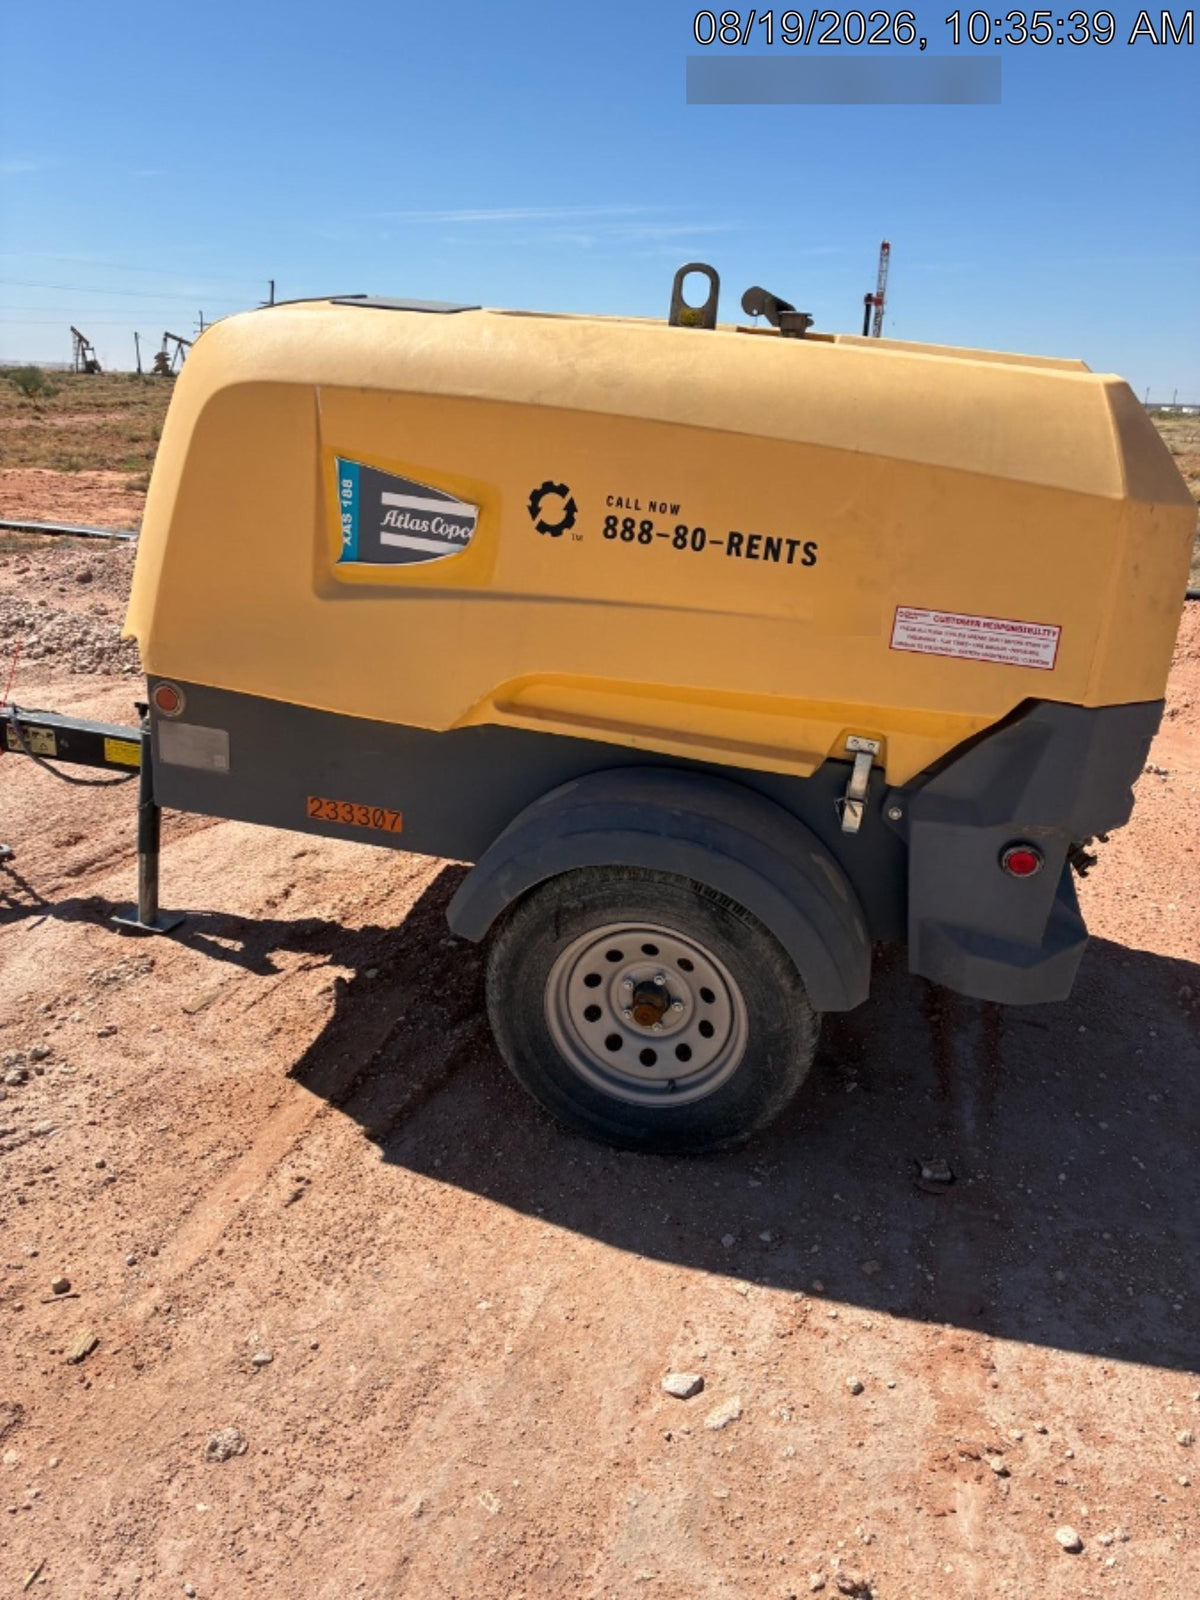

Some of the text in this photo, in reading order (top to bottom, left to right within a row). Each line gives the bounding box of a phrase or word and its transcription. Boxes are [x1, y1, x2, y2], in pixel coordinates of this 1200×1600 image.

[341, 479, 353, 546] XAS 188
[380, 510, 430, 533] Atlas
[606, 495, 681, 516] CALL NOW
[602, 515, 819, 567] 888-80-RENTS
[310, 797, 400, 830] 233307
